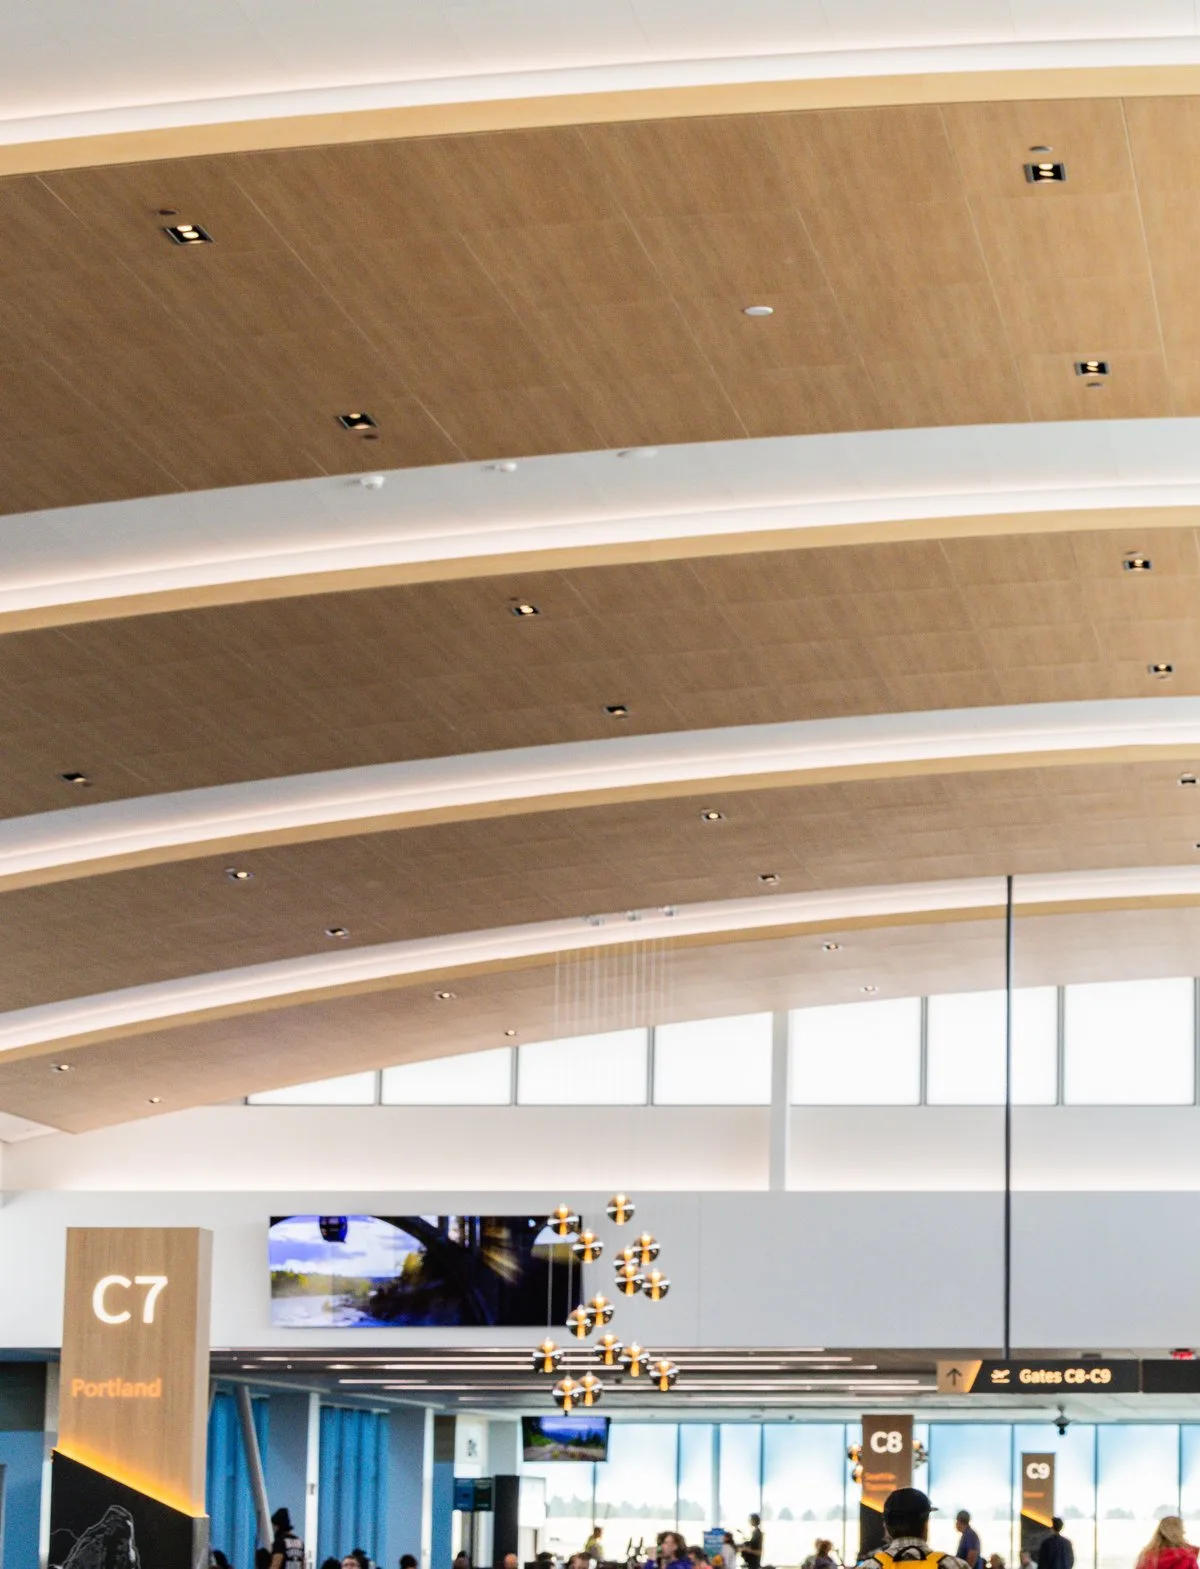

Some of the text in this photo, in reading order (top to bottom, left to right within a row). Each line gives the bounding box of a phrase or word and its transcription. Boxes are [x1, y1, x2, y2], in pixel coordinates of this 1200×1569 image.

[92, 1274, 169, 1325] C7
[1019, 1368, 1112, 1384] Gates C8-C9
[71, 1377, 163, 1399] Portland
[870, 1430, 903, 1454] C8
[1026, 1462, 1051, 1480] C9
